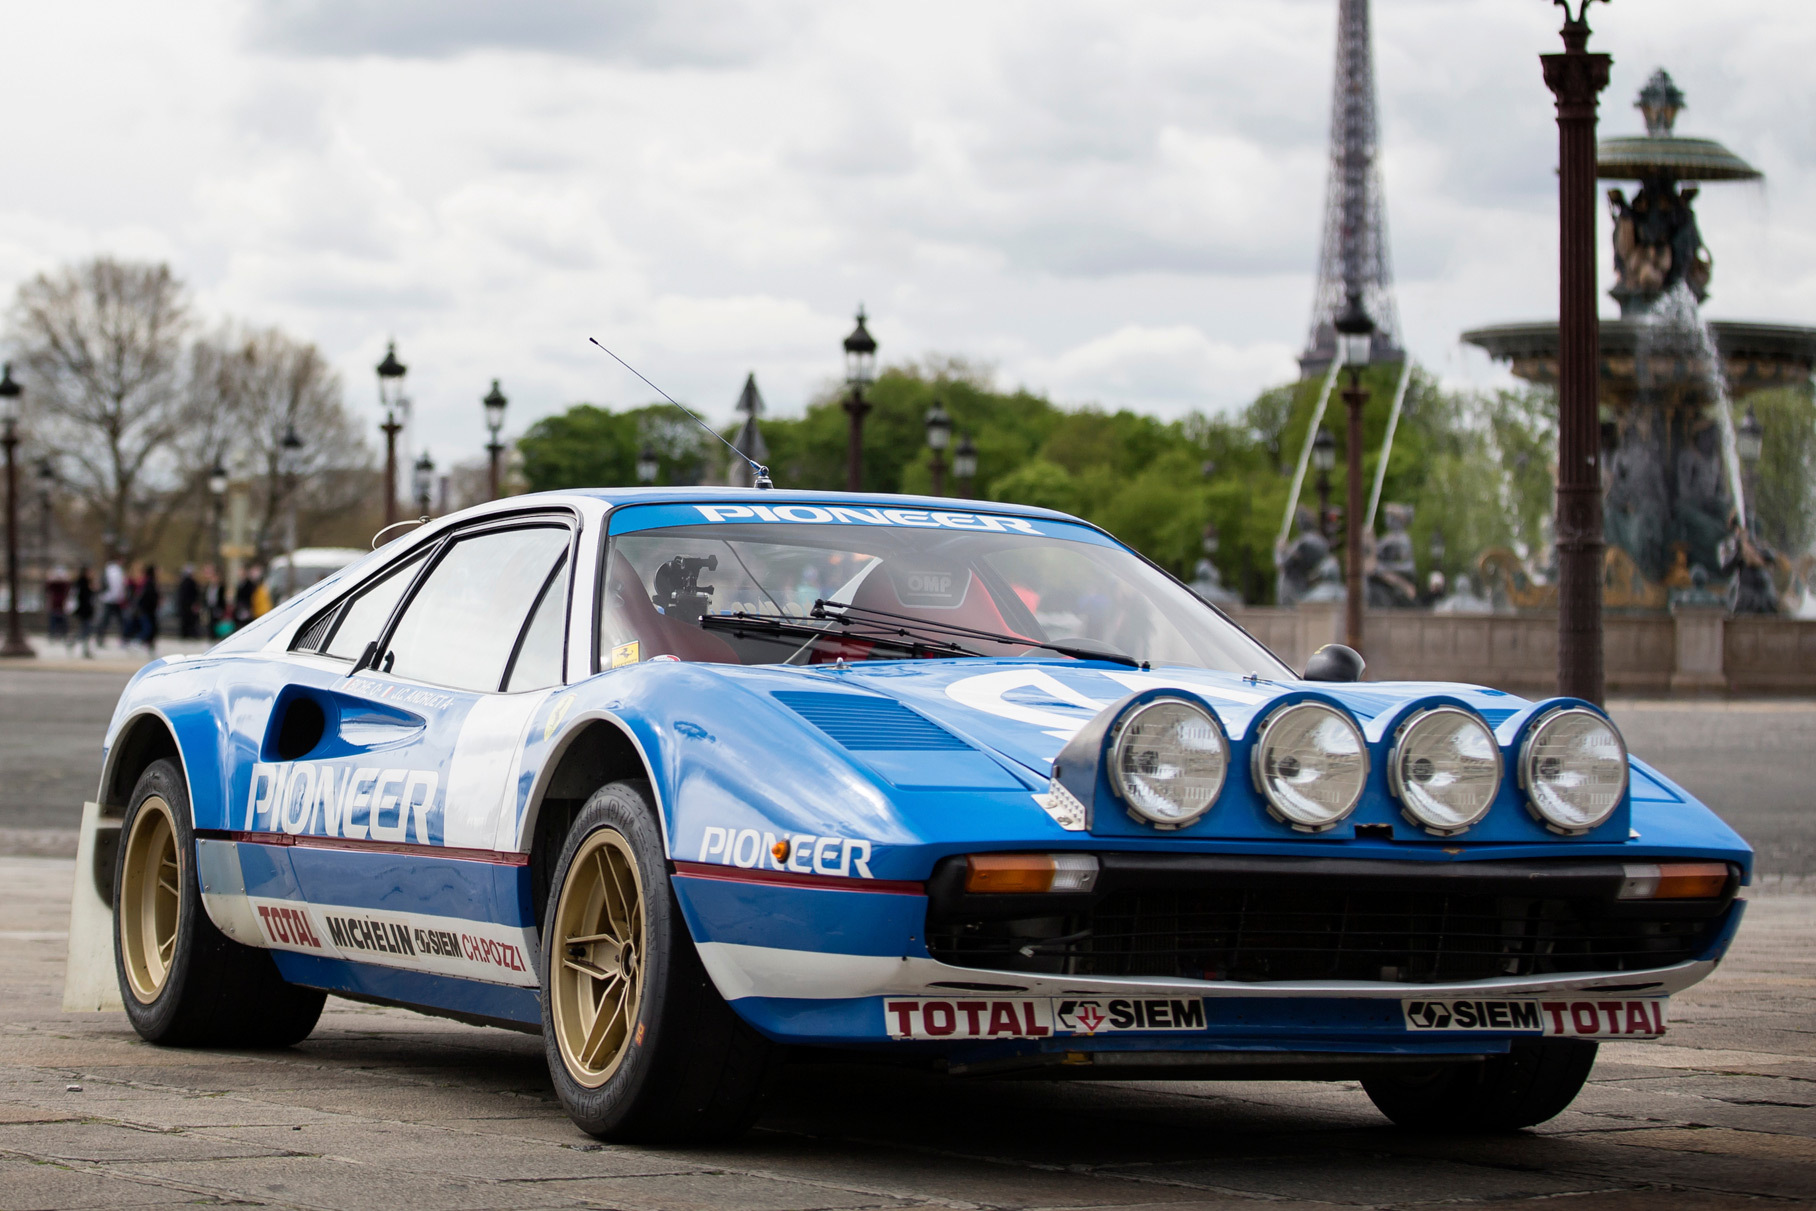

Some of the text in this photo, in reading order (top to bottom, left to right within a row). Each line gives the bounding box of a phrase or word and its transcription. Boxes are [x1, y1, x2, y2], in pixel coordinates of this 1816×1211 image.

[692, 504, 1046, 536] PIONEER
[908, 575, 952, 592] OMP
[245, 762, 439, 844] PIONEER
[698, 826, 874, 879] PIONEER
[258, 905, 322, 948] TOTAL
[325, 915, 416, 956] MICHELIN
[428, 929, 463, 958] SIEM
[888, 1001, 1050, 1037] TOTAL
[1109, 1000, 1204, 1029] SIEM
[1454, 1000, 1541, 1029] SIEM
[1543, 1001, 1666, 1035] TOTAL
